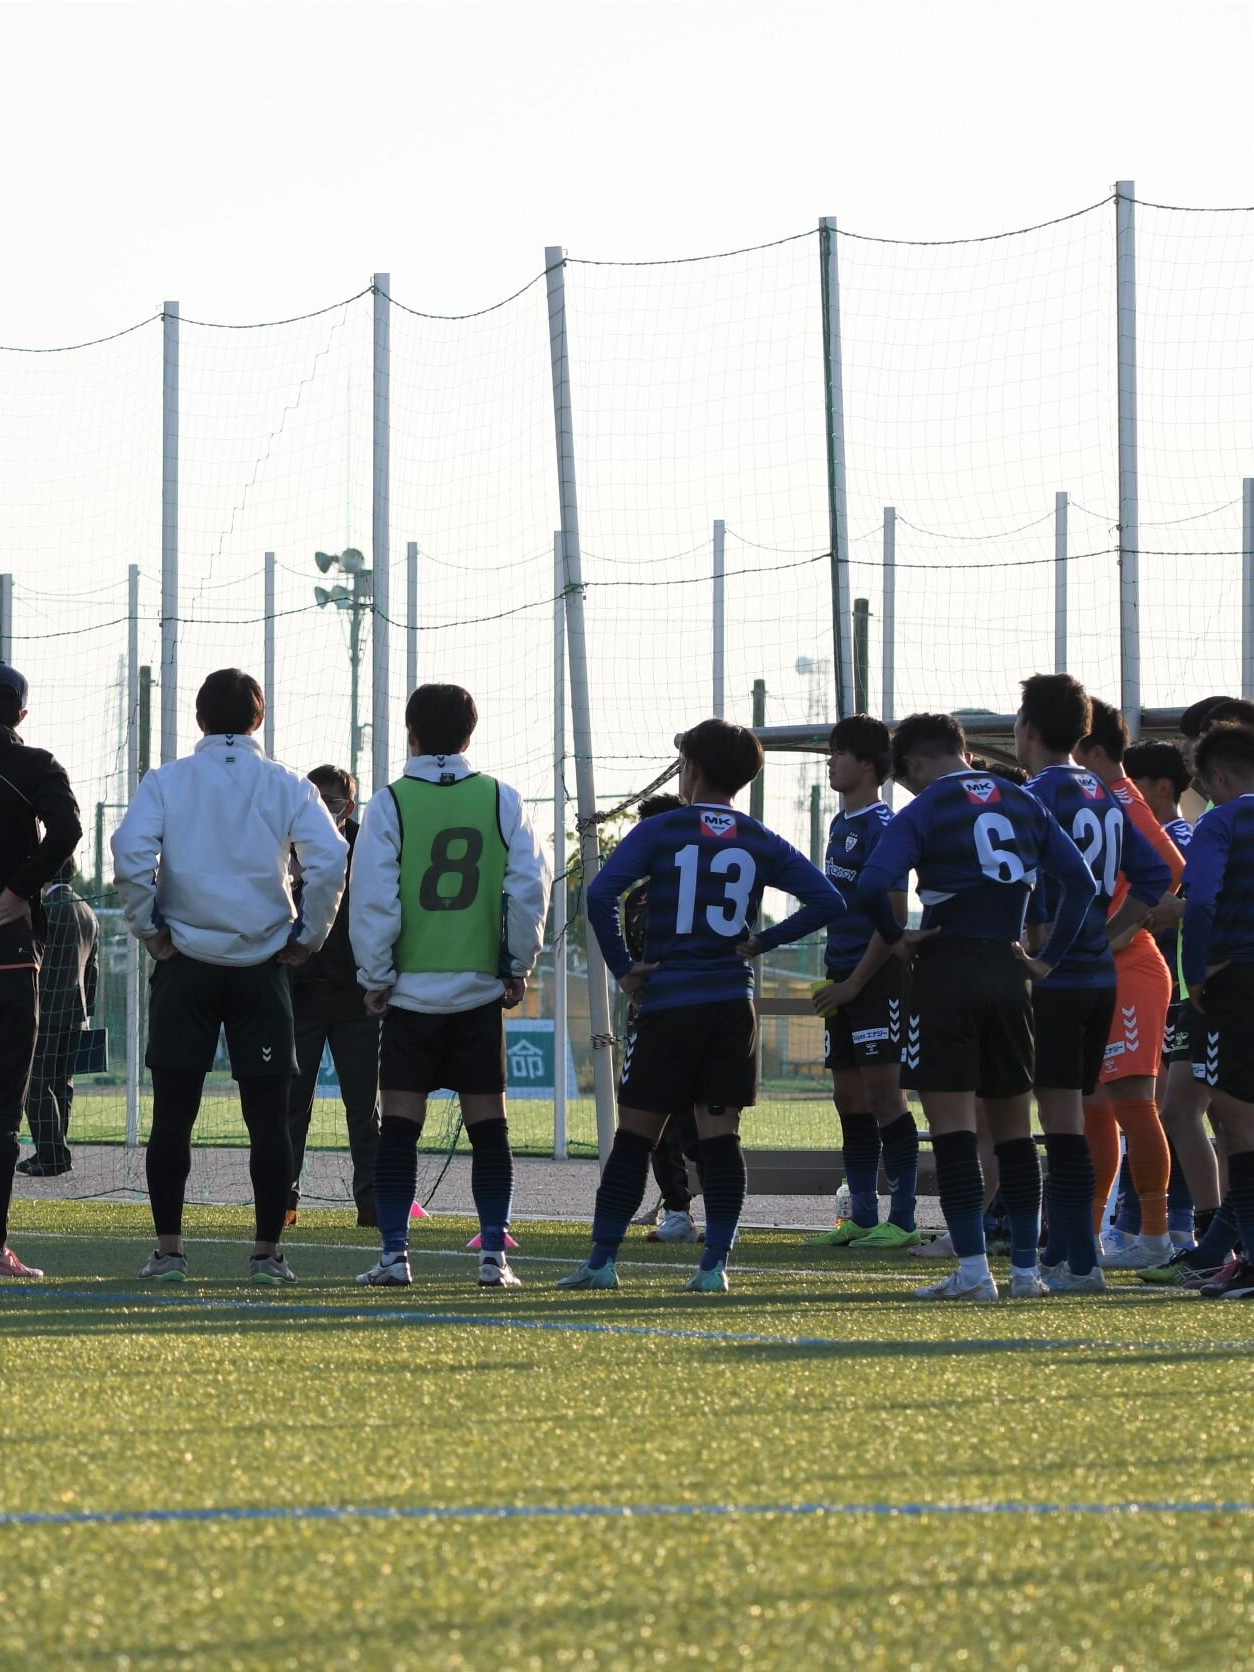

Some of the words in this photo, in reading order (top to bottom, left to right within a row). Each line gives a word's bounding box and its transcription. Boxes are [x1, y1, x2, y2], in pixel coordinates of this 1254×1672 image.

[966, 782, 992, 791] MK
[1078, 779, 1096, 787] MK
[705, 815, 732, 826] MK
[973, 812, 1025, 884] 6
[1073, 807, 1123, 897] 20
[419, 826, 484, 912] 8
[674, 844, 756, 937] 13
